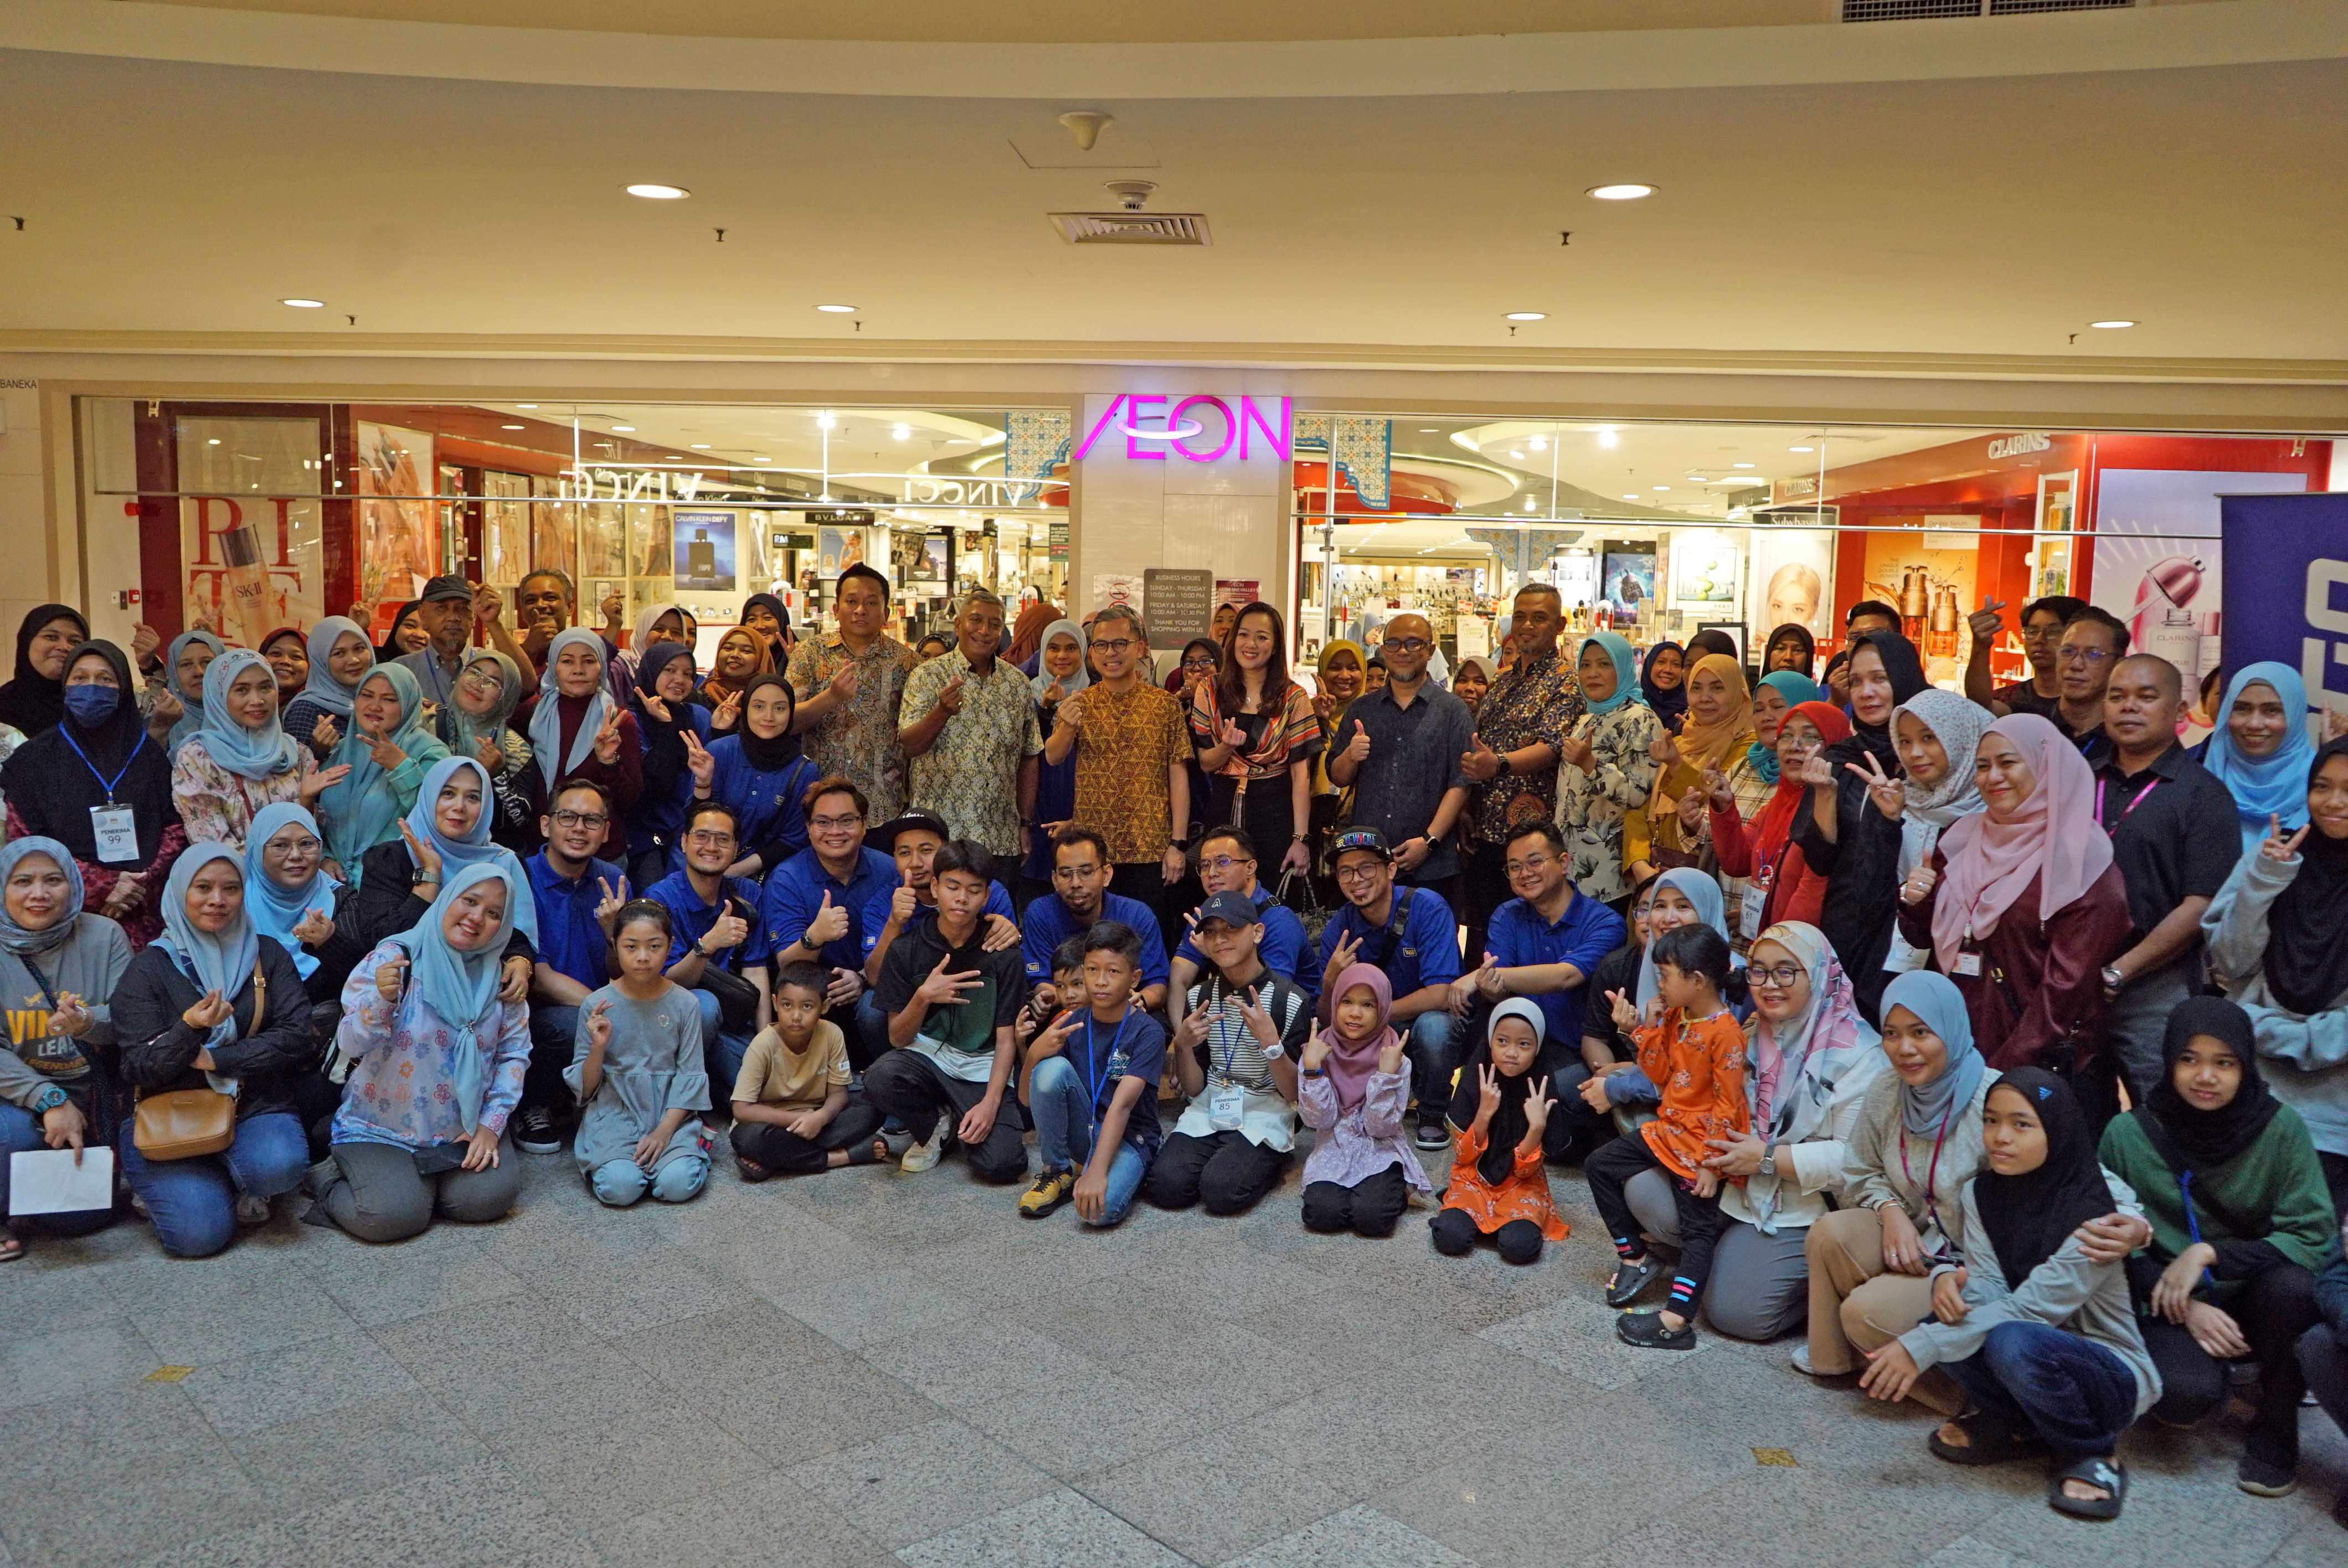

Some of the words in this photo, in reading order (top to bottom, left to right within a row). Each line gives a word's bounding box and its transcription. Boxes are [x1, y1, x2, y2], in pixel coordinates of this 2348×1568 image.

[1988, 433, 2051, 459] CLARINS
[235, 582, 262, 598] SK-II
[108, 835, 121, 845] 99
[1211, 898, 1222, 908] A
